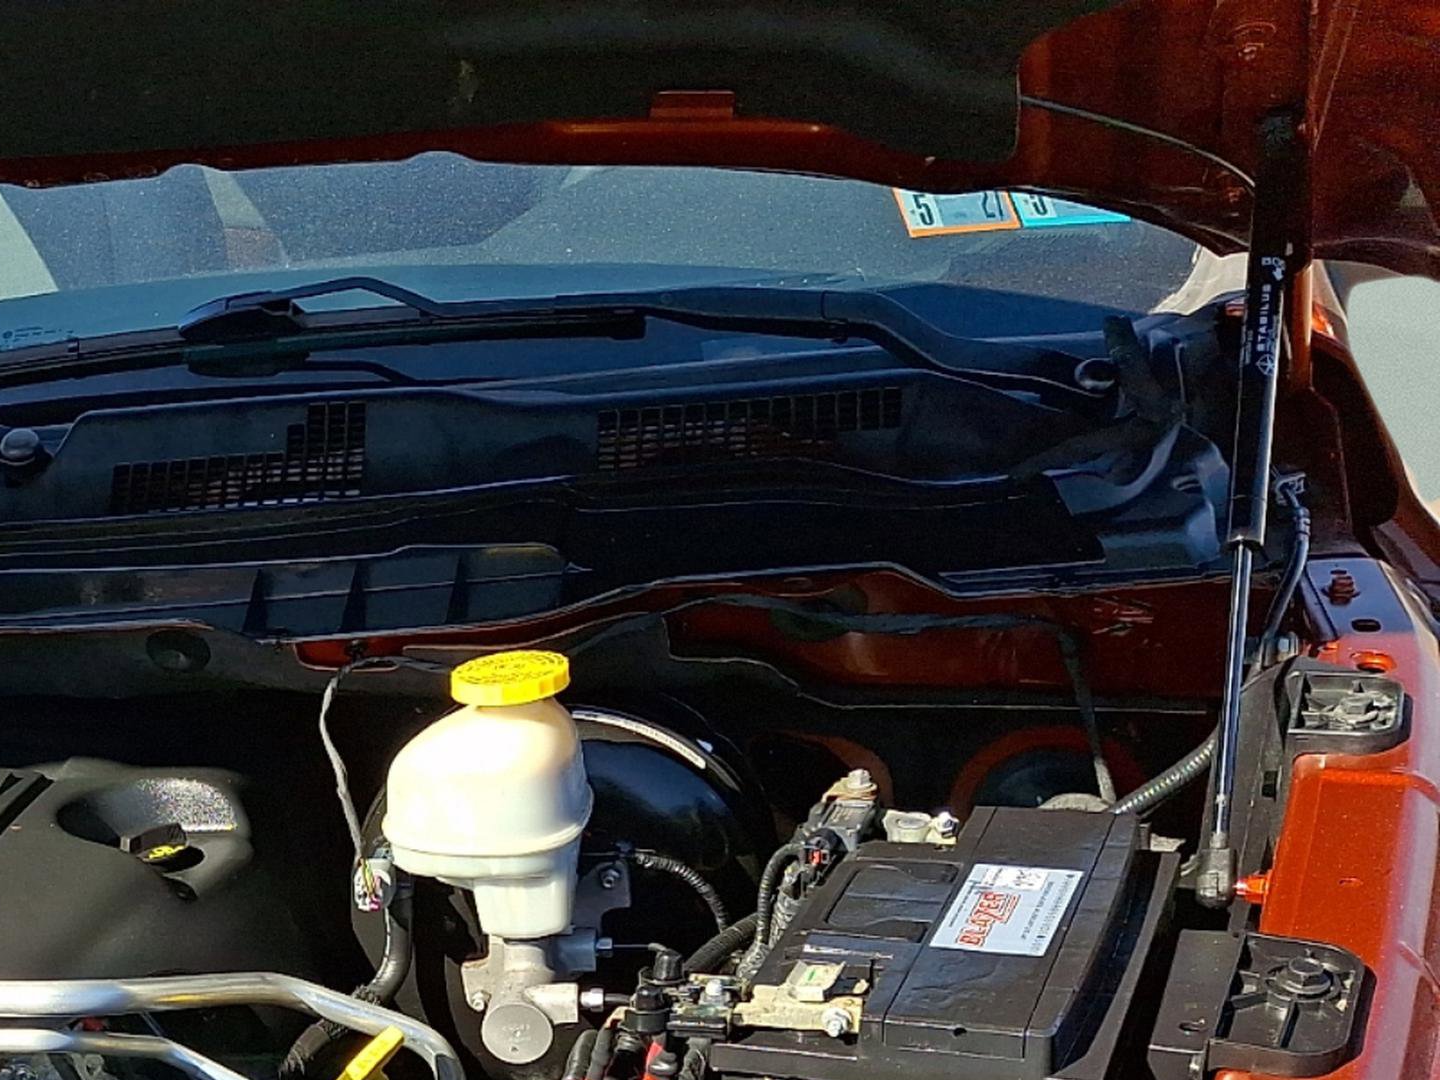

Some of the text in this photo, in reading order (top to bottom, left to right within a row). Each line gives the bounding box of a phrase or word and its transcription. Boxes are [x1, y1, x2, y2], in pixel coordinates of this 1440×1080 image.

[913, 194, 935, 226] 5
[1256, 284, 1272, 352] STABILUS
[956, 891, 1016, 947] BLAZER
